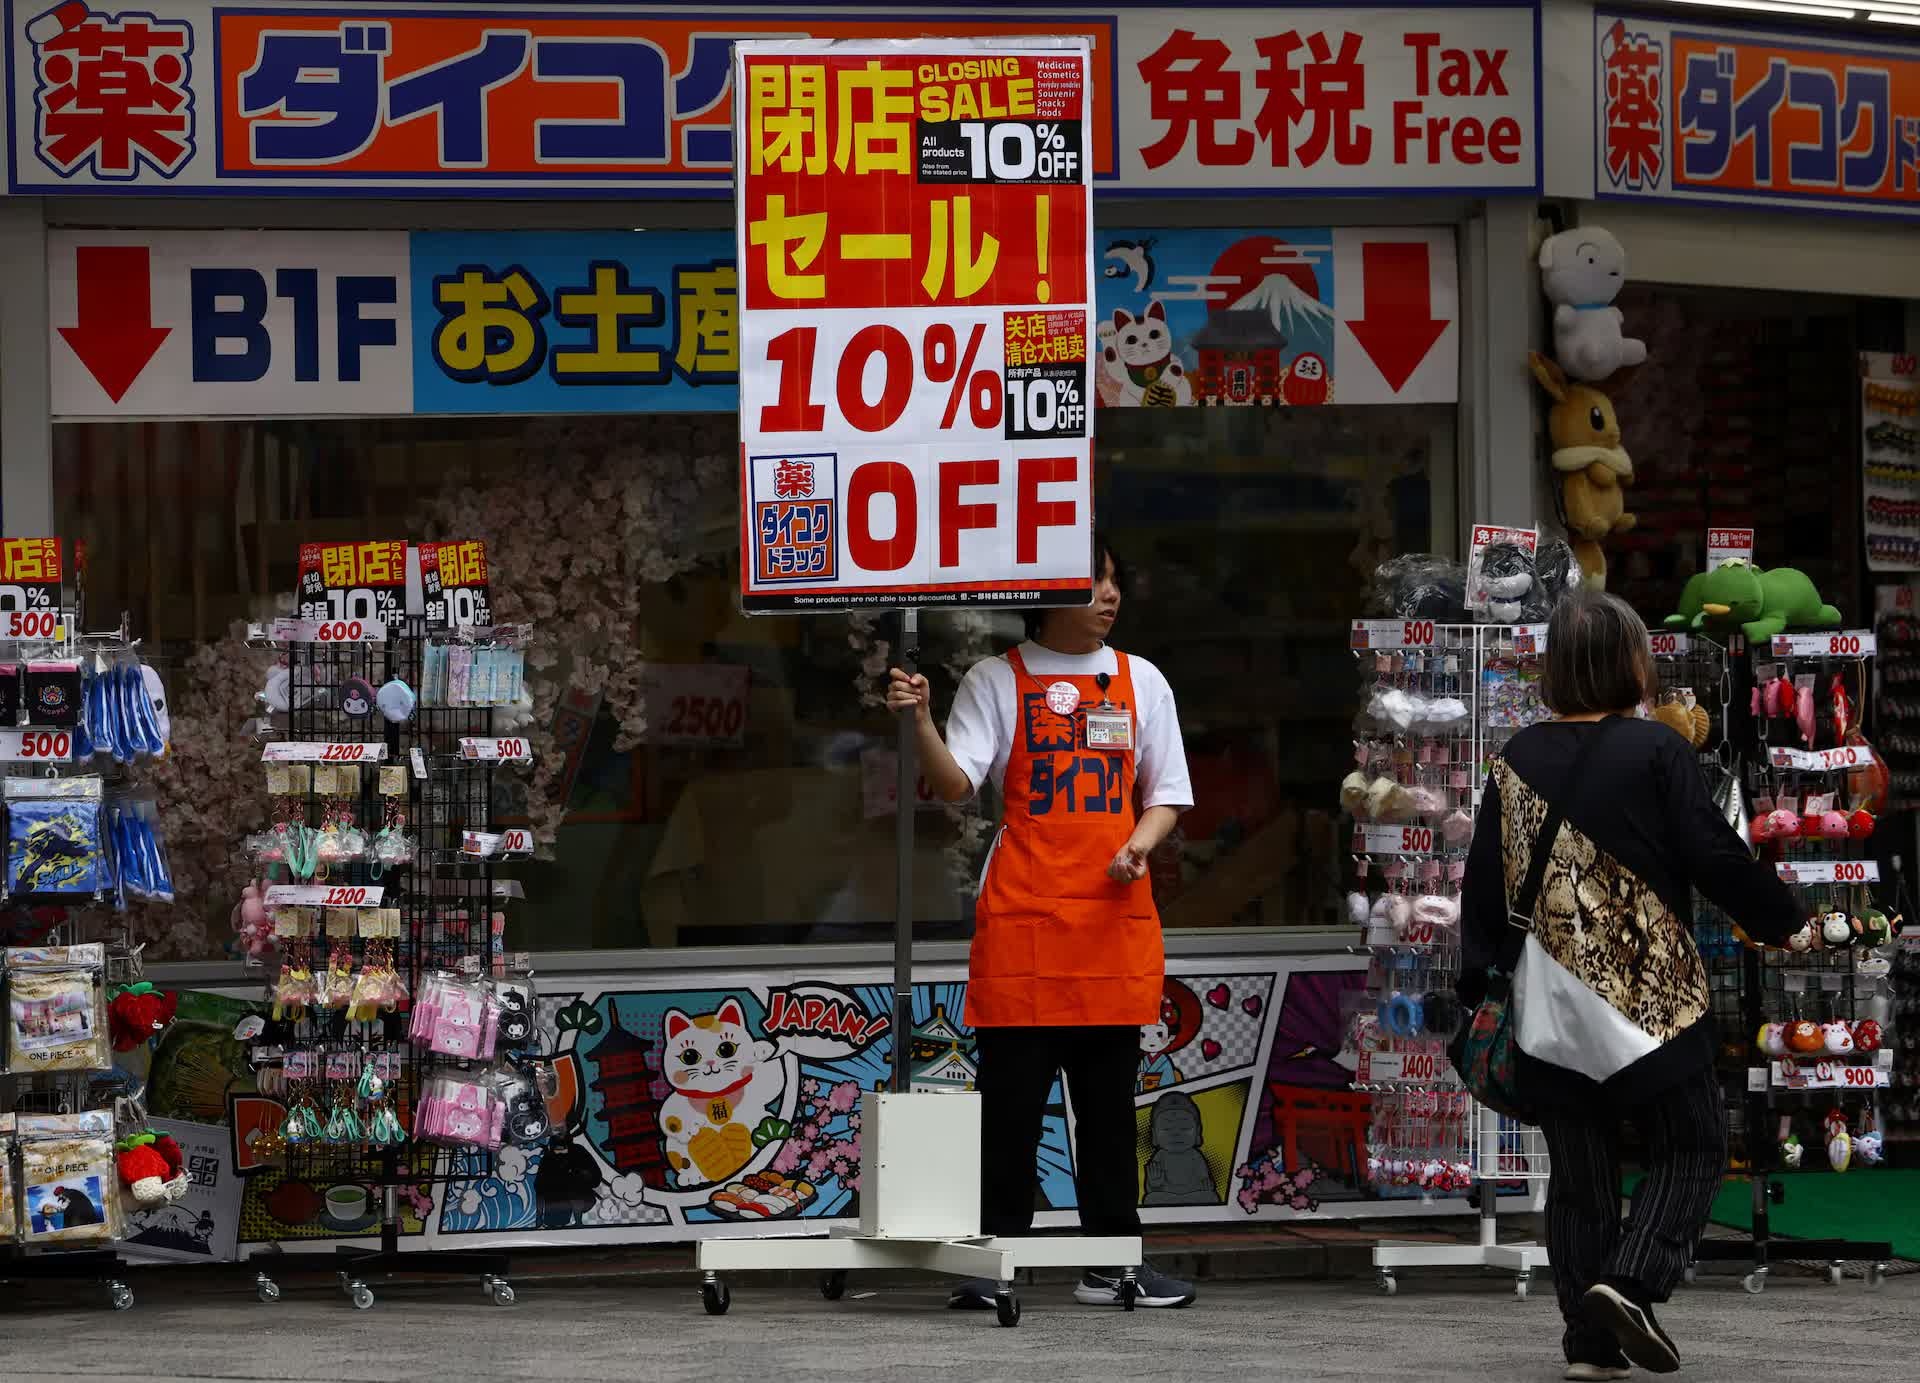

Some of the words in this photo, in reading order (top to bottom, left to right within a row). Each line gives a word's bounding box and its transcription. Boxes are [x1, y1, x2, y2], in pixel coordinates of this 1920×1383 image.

[919, 57, 1020, 83] CLOSING
[1037, 61, 1076, 69] Medicine
[1037, 71, 1080, 79] Cosmetics
[1404, 33, 1509, 96] Tax
[38, 14, 192, 176] 薬
[920, 78, 1036, 124] SALE
[1037, 89, 1075, 98] Souvenir
[1037, 99, 1066, 108] Snacks
[1136, 29, 1372, 171] 免税
[750, 61, 915, 176] 閉店
[1037, 109, 1062, 117] Foods
[1604, 28, 1663, 188] 薬
[1393, 101, 1521, 165] Free
[1680, 50, 1920, 194] ダイコクド
[922, 136, 937, 147] All
[922, 148, 965, 159] products
[1037, 152, 1078, 178] OFF
[191, 268, 397, 382] B1F
[1006, 314, 1046, 341] 关店
[1006, 335, 1085, 367] 清仓大甩卖
[759, 323, 1003, 433] 10%
[1008, 368, 1042, 378] 所有产品
[1057, 405, 1084, 429] OFF
[775, 459, 814, 498] 薬
[762, 504, 829, 546] ダイコク
[847, 456, 1078, 571] OFF
[1710, 532, 1730, 547] 免税
[0, 537, 43, 581] 店
[42, 538, 58, 577] SALE
[322, 541, 390, 586] 閉店
[390, 542, 403, 580] SALE
[438, 541, 480, 586] 閉店
[767, 545, 826, 574] ドラッグ
[300, 601, 328, 620] 全品
[816, 596, 849, 605] products
[10, 612, 54, 637] 500
[425, 601, 445, 620] 全品
[474, 608, 491, 626] OFF
[319, 621, 362, 641] 600
[1404, 621, 1433, 645] 500
[1651, 636, 1676, 653] 500
[1830, 636, 1860, 654] 800
[1054, 705, 1071, 714] OK
[22, 732, 69, 757] 500
[322, 744, 364, 760] 1200
[497, 739, 522, 757] 500
[1028, 754, 1123, 816] ダイコク
[503, 832, 524, 850] 00
[1402, 827, 1431, 852] 500
[1834, 863, 1865, 880] 800
[325, 887, 366, 905] 1200
[763, 992, 891, 1044] JAPAN!
[29, 1052, 48, 1061] ONE
[50, 1050, 73, 1060] PIECE
[1401, 1055, 1433, 1078] 1400
[1845, 1068, 1874, 1085] 900
[711, 1100, 729, 1120] 福
[44, 1165, 64, 1175] ONE
[65, 1162, 89, 1173] PIECE
